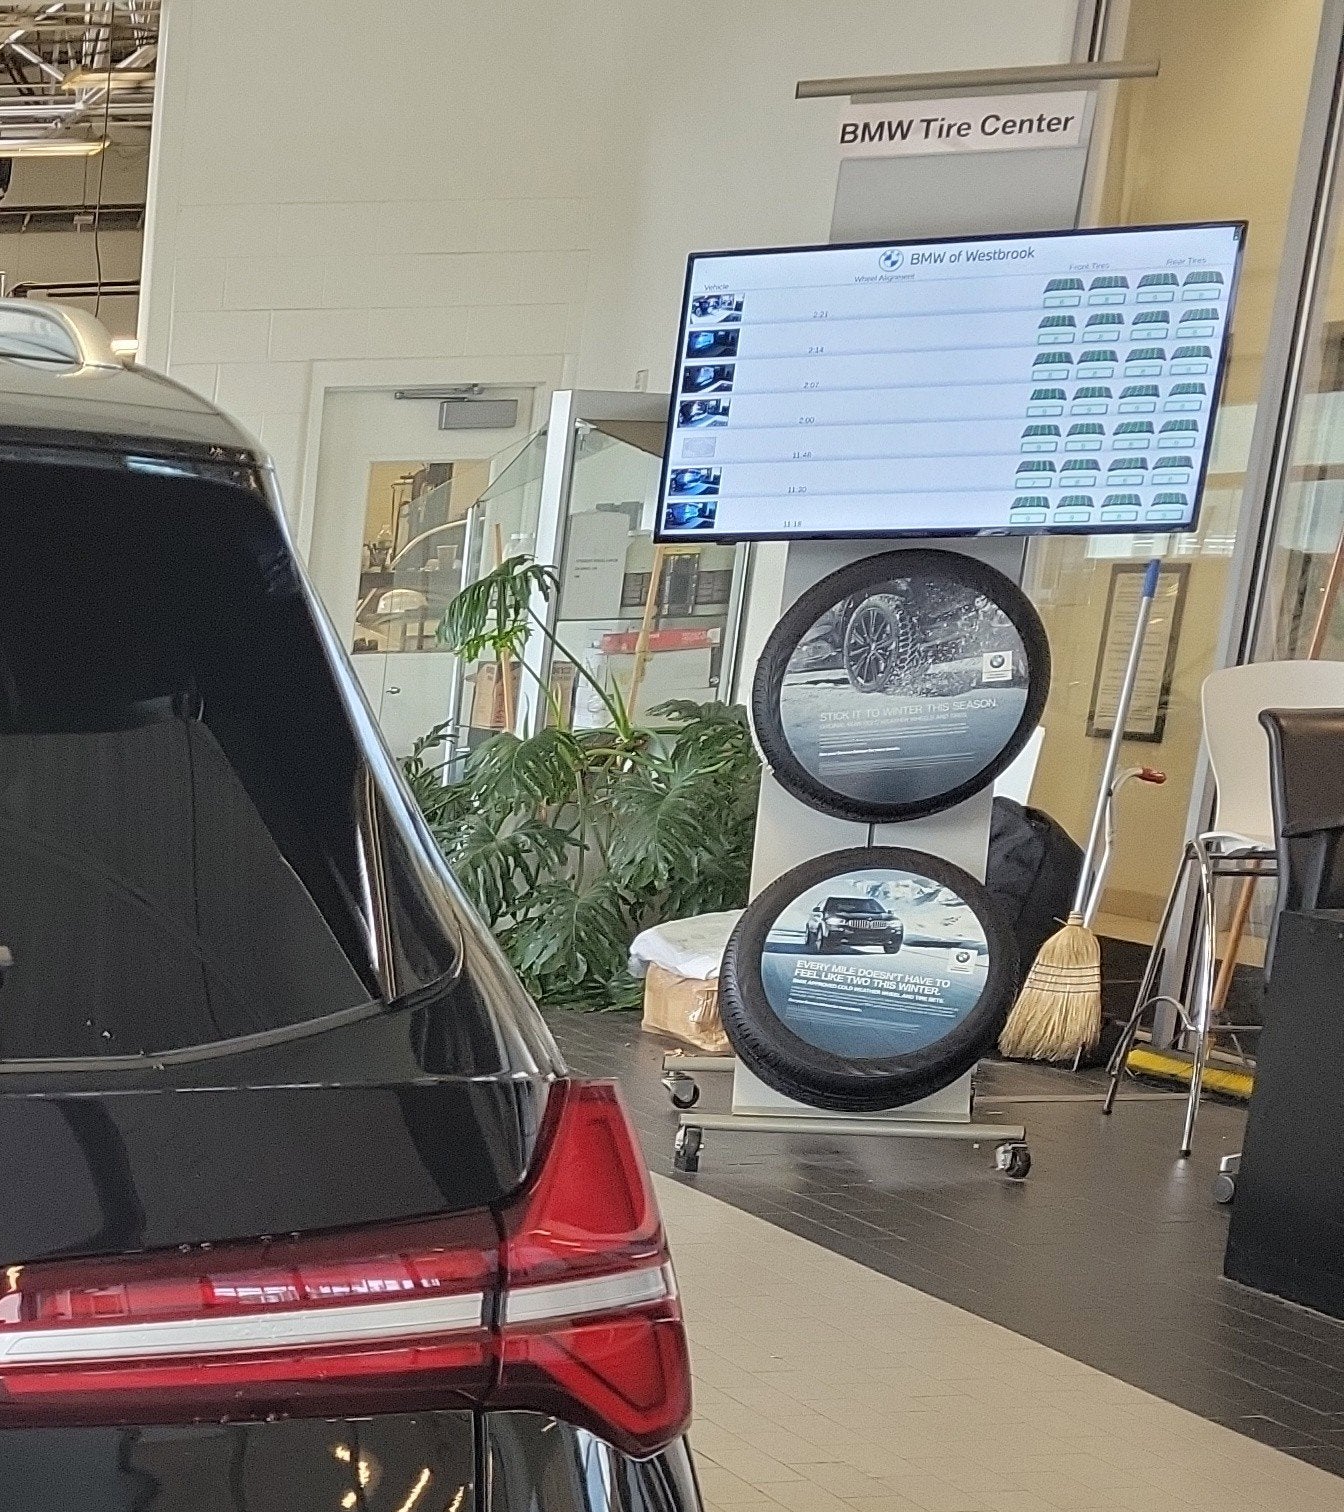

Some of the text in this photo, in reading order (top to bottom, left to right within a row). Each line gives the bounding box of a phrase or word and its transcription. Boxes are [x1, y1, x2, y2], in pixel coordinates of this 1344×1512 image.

[839, 113, 1075, 144] BMW Tire Center
[910, 246, 1035, 266] BMW of Westbrook
[820, 712, 849, 721] STICK
[866, 708, 880, 718] TO
[883, 705, 923, 716] WINTER
[927, 702, 950, 713] THIS
[794, 968, 941, 996] FEEL LIKE TWO THIS WINTER.
[796, 960, 951, 989] EVERY MILE DOESN'T HAVE TO
